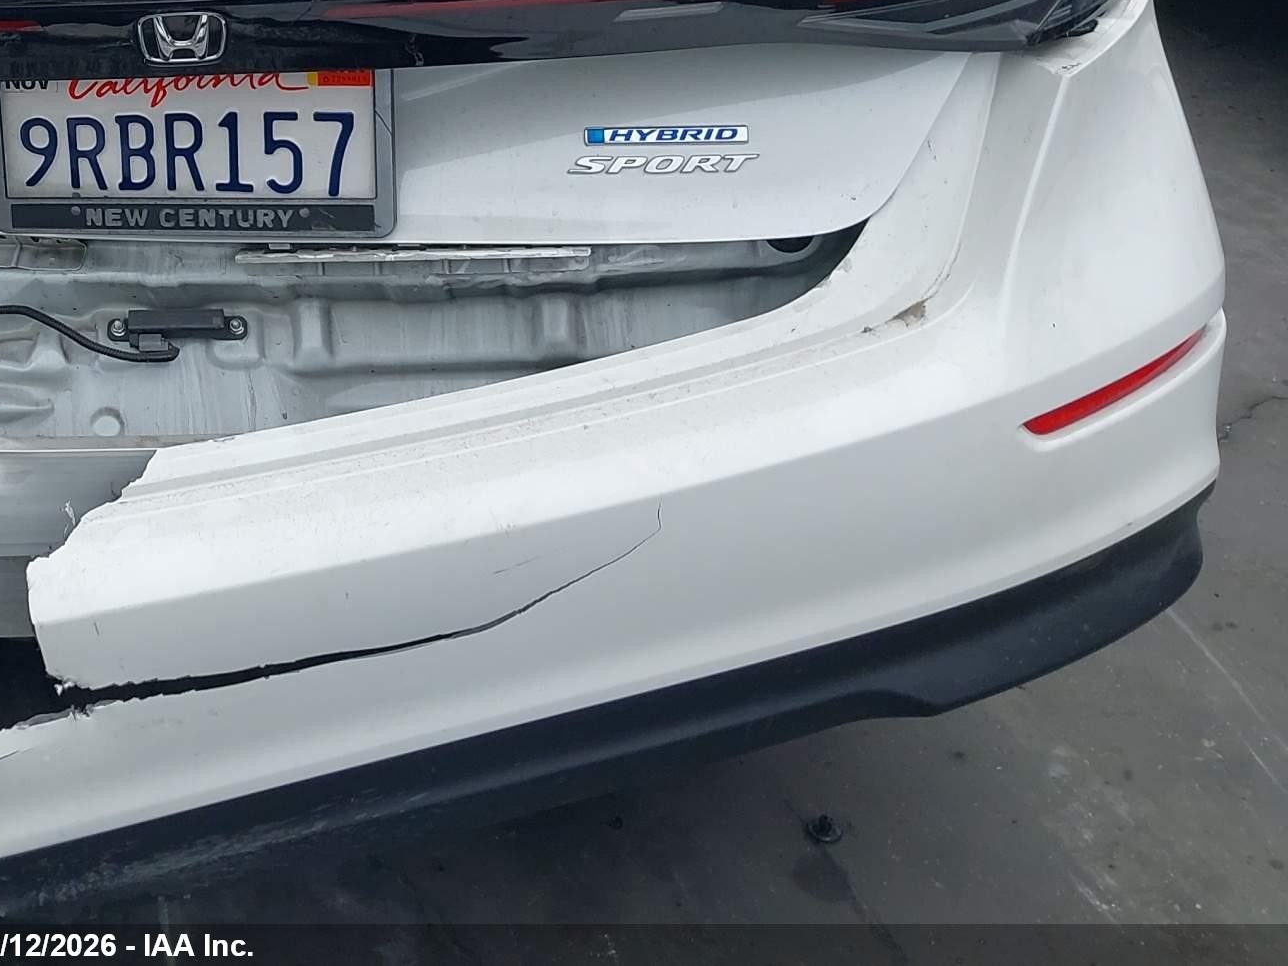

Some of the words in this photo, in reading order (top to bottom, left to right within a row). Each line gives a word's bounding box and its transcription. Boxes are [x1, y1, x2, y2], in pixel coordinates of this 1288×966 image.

[610, 128, 739, 142] HYBRID
[20, 111, 354, 197] 9RBR157
[568, 154, 760, 175] SPORT
[85, 207, 148, 228] NEW
[159, 208, 294, 228] CENTURY
